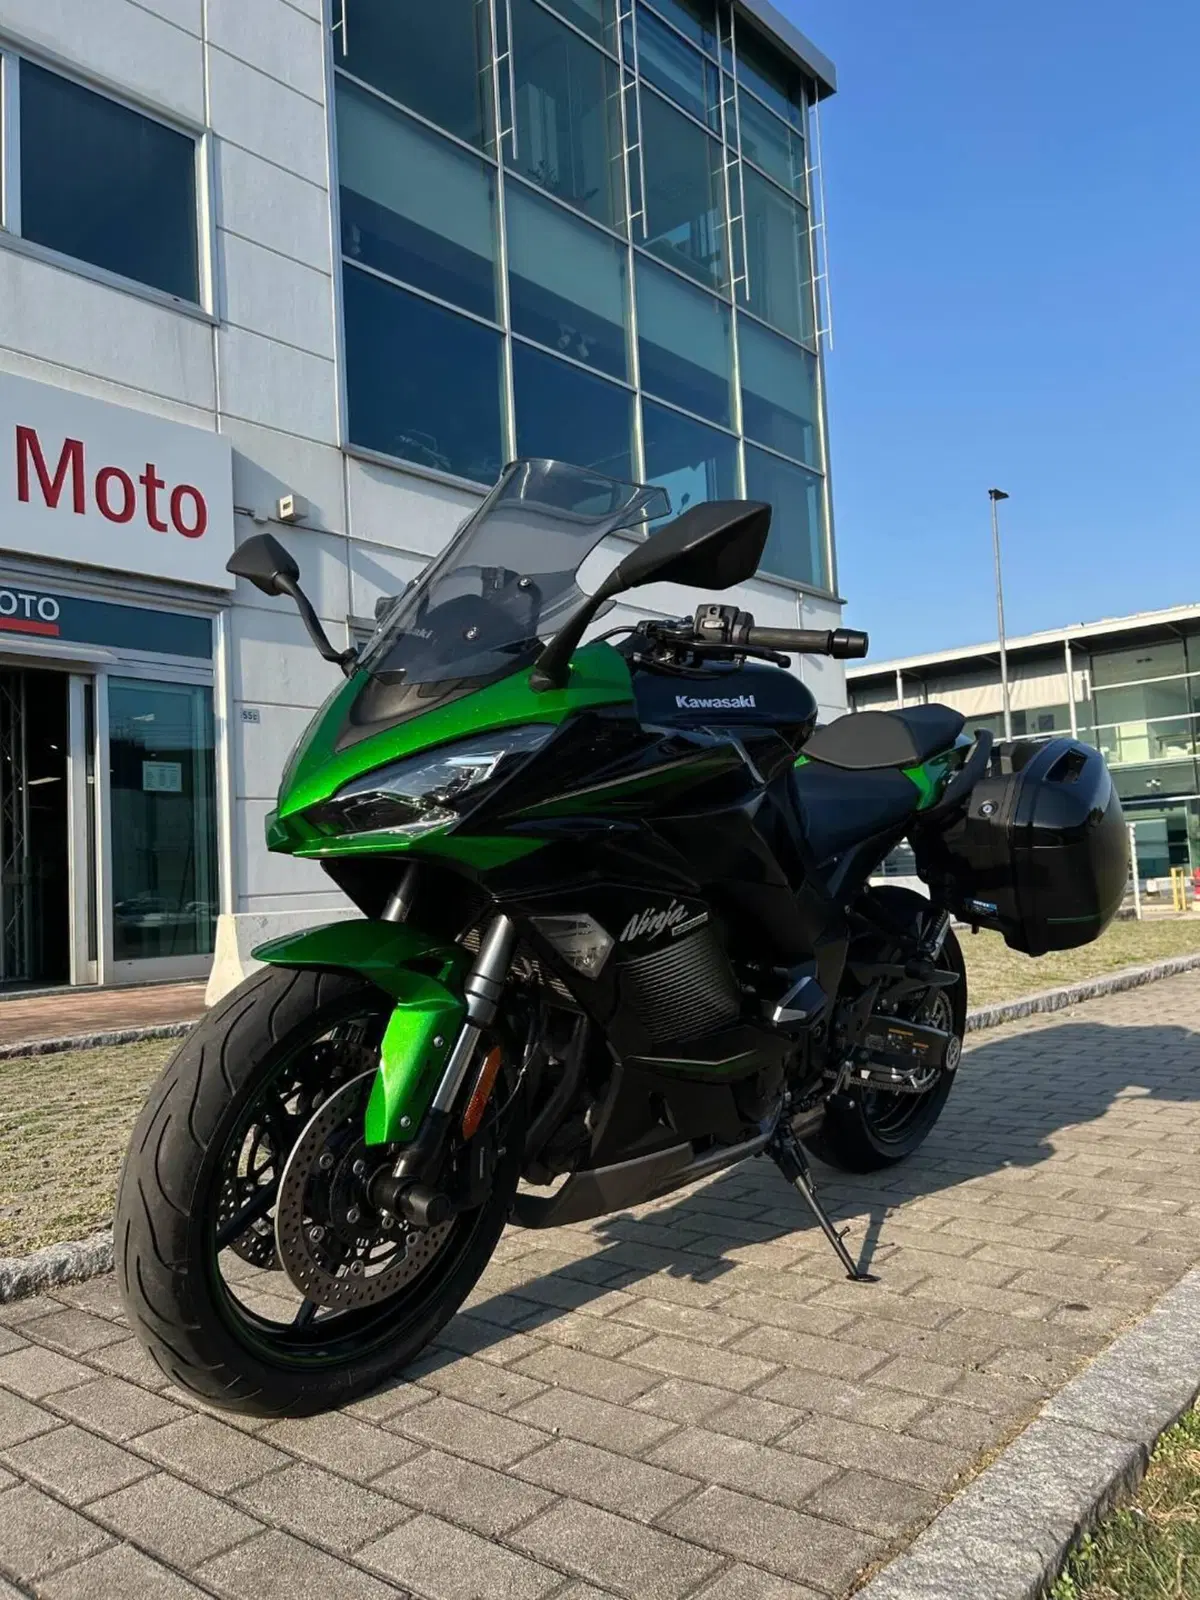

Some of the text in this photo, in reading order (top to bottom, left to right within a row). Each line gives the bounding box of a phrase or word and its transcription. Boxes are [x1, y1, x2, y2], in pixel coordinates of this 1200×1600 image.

[16, 424, 208, 539] Moto
[675, 694, 756, 709] Kawasaki
[619, 898, 689, 942] Ninja
